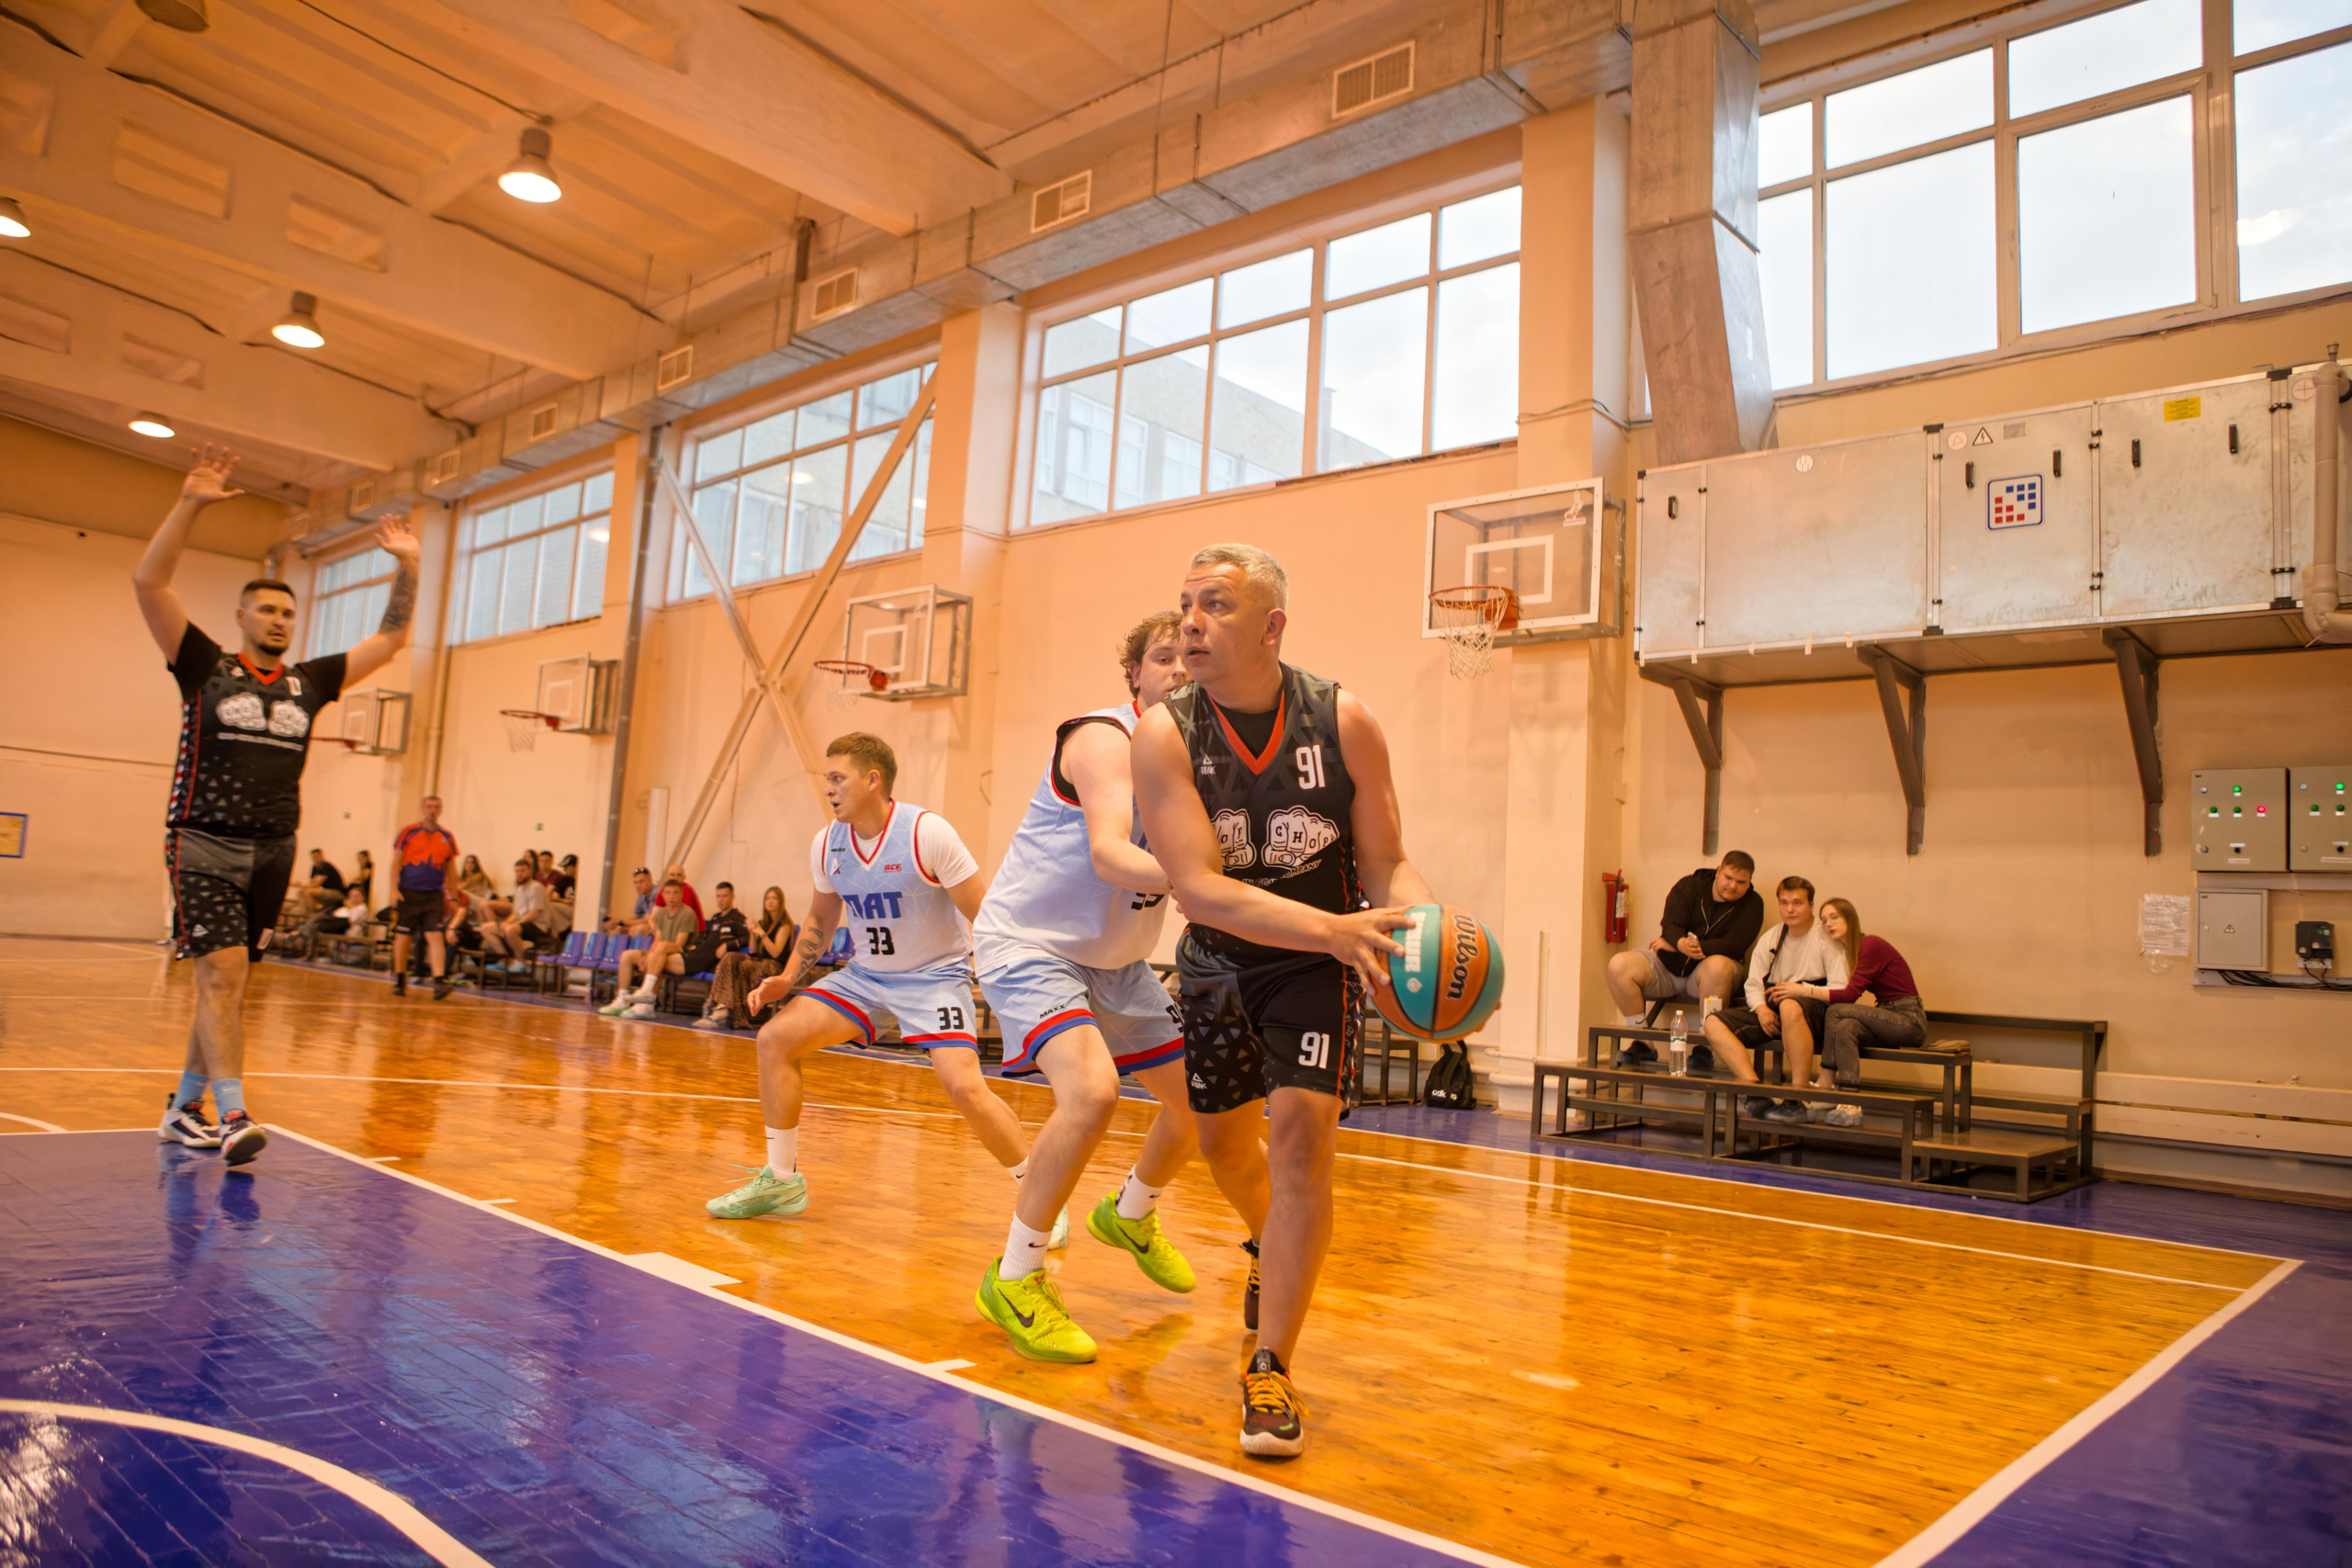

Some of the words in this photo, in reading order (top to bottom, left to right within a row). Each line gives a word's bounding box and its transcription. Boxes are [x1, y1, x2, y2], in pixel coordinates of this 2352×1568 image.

[1295, 744, 1326, 789] 91
[1280, 858, 1323, 878] OMPANY
[865, 926, 895, 955] 33
[1445, 914, 1479, 1000] Wilson
[936, 1007, 965, 1030] 33
[1039, 1004, 1066, 1019] MAXX
[1165, 1004, 1184, 1033] 9
[1298, 1032, 1330, 1069] 91
